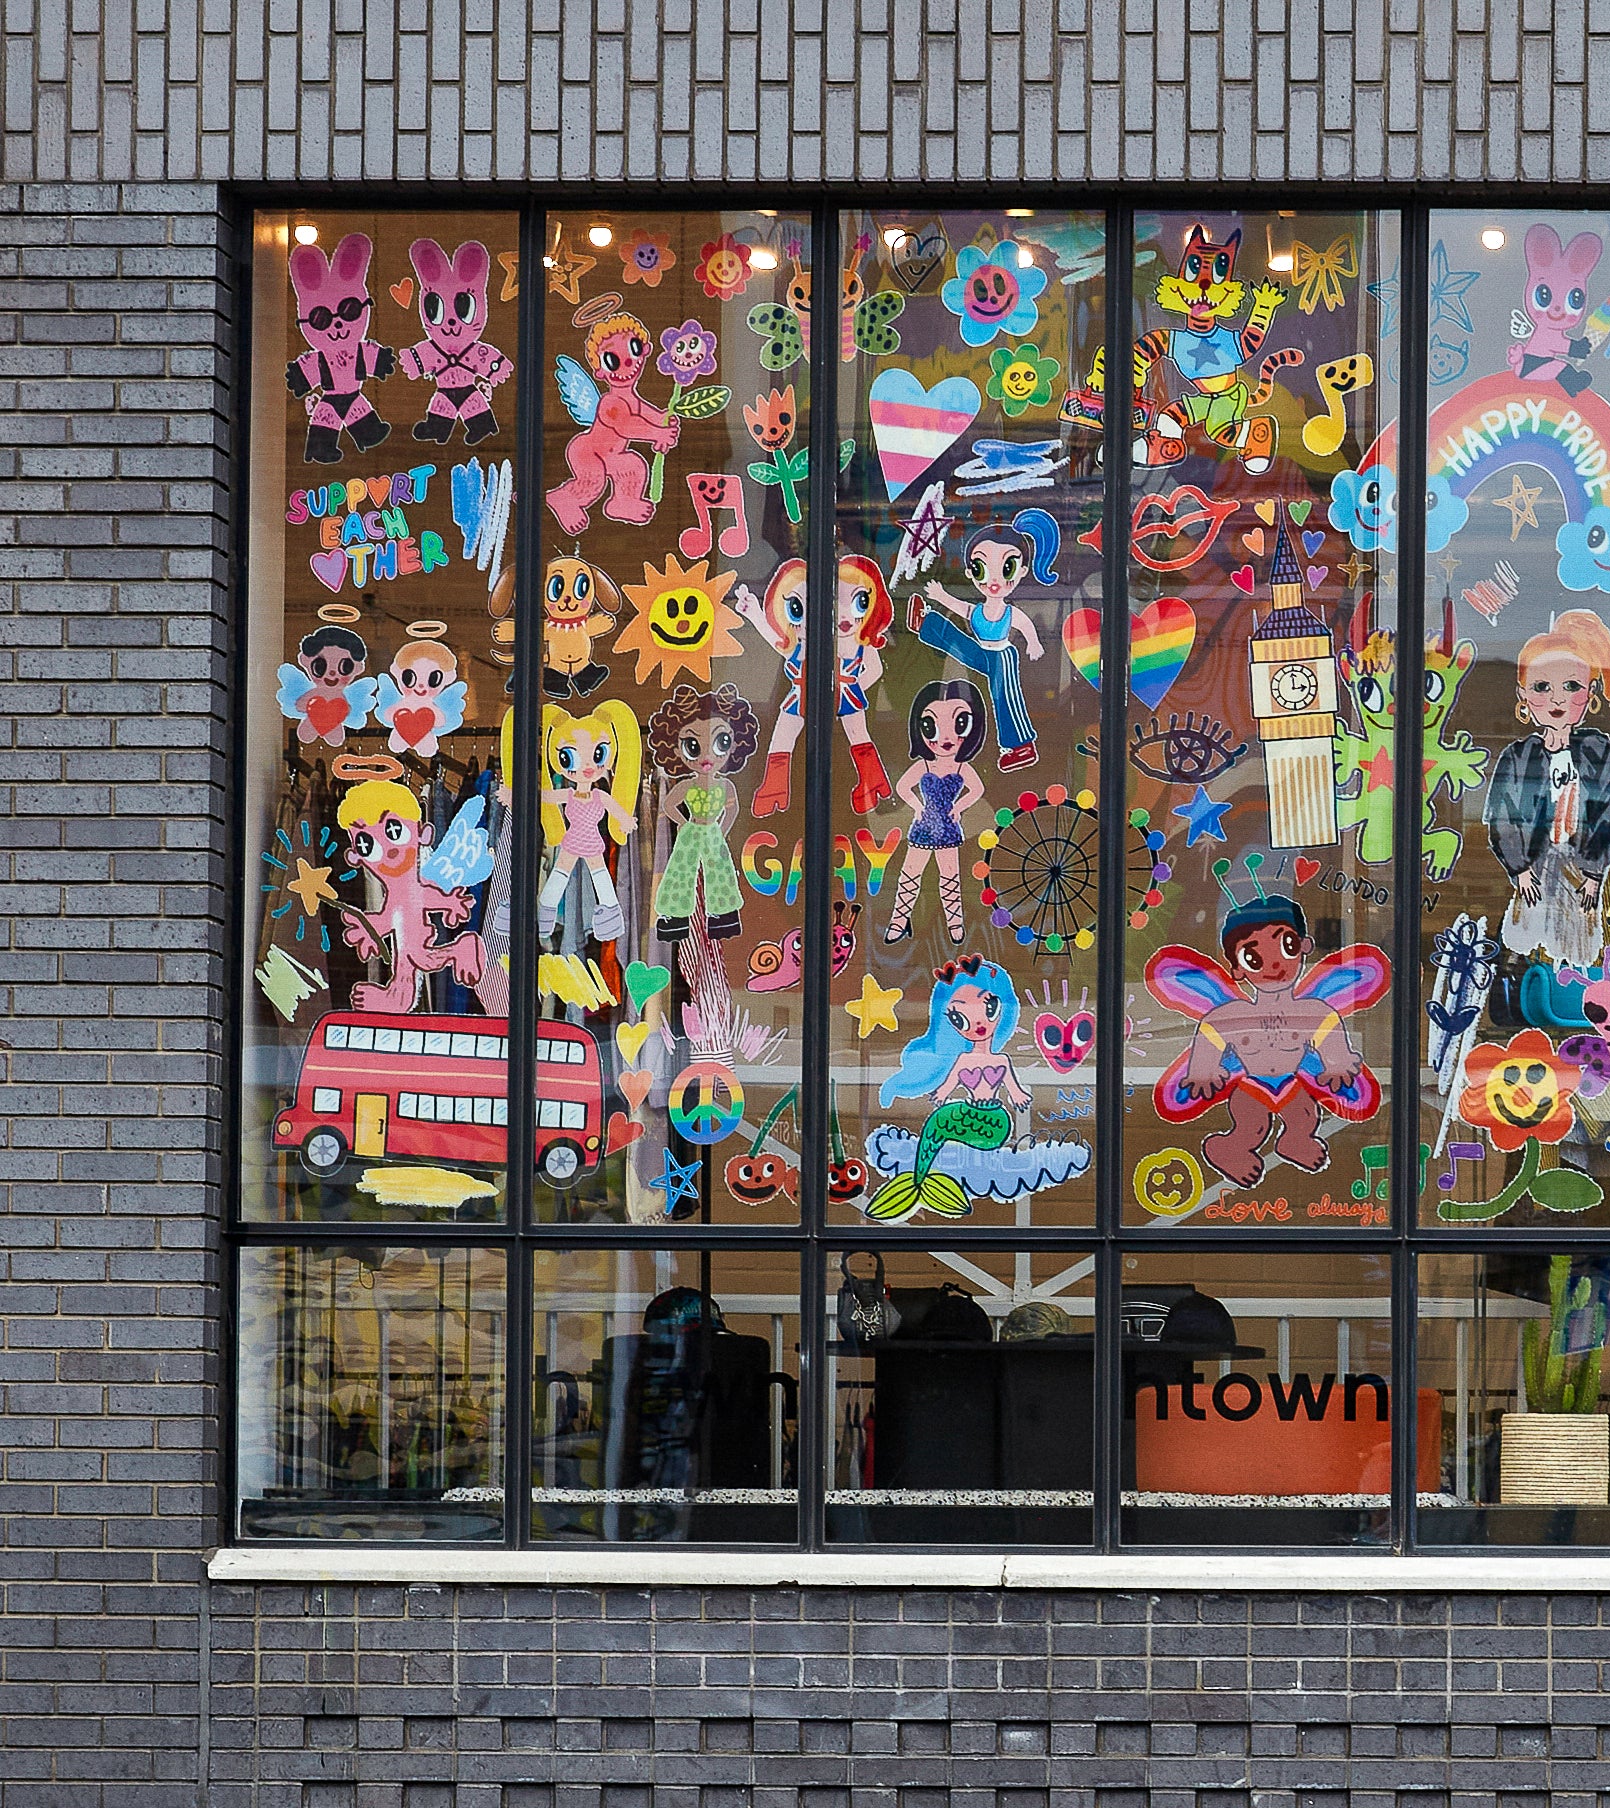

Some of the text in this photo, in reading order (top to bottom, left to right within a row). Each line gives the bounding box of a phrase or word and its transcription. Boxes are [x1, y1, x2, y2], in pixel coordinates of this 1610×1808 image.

[1438, 398, 1548, 478] HAPPY
[319, 507, 410, 549] EACH
[741, 830, 903, 906] GAY
[1317, 864, 1441, 914] LONDON
[1204, 1188, 1293, 1222] Love
